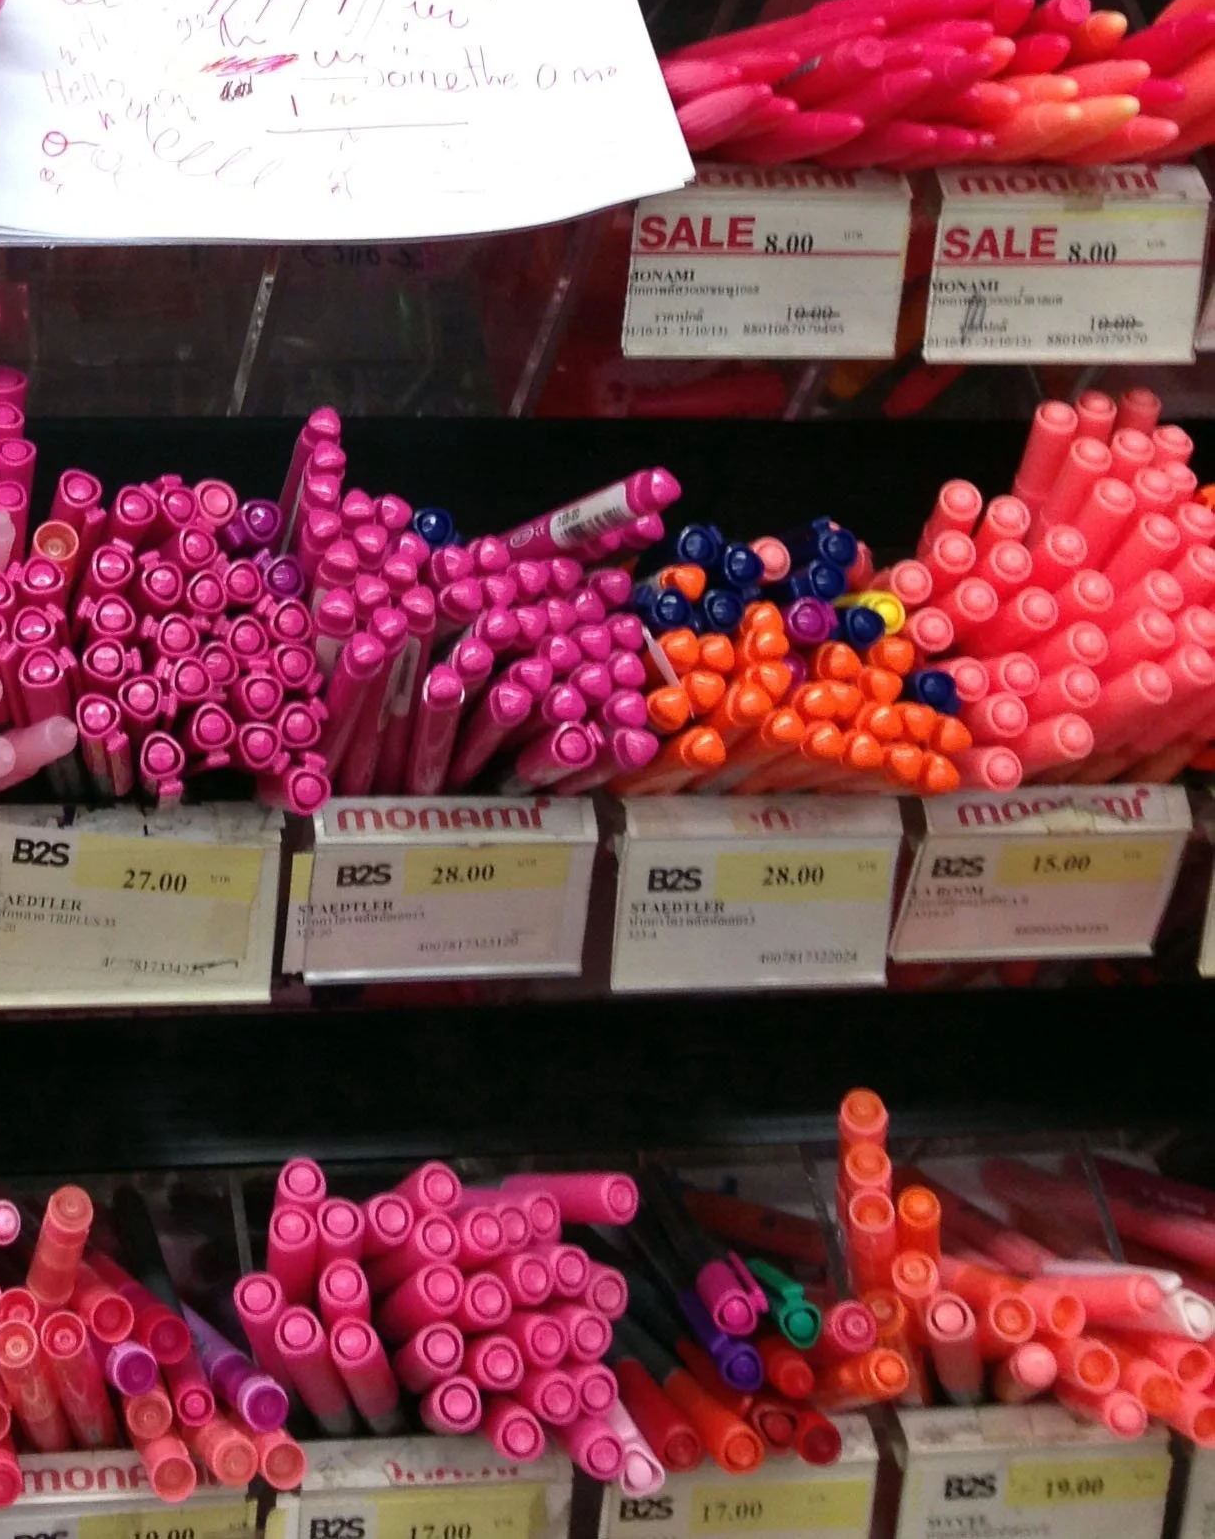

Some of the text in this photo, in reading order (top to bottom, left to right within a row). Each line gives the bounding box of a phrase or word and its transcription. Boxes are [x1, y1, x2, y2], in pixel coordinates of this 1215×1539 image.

[639, 216, 813, 254] SALE 8.00
[943, 227, 1117, 263] SALE 8.00
[12, 838, 187, 894] B2S 27.00
[337, 863, 495, 887] B2S 28.00
[649, 864, 824, 893] B2S 28.00
[931, 853, 1090, 879] B2S 15.00
[298, 901, 393, 913] STAEDTLER
[944, 1473, 1104, 1501] B2S 19.00
[620, 1496, 763, 1523] B2S 17.00
[310, 1519, 365, 1539] B2S
